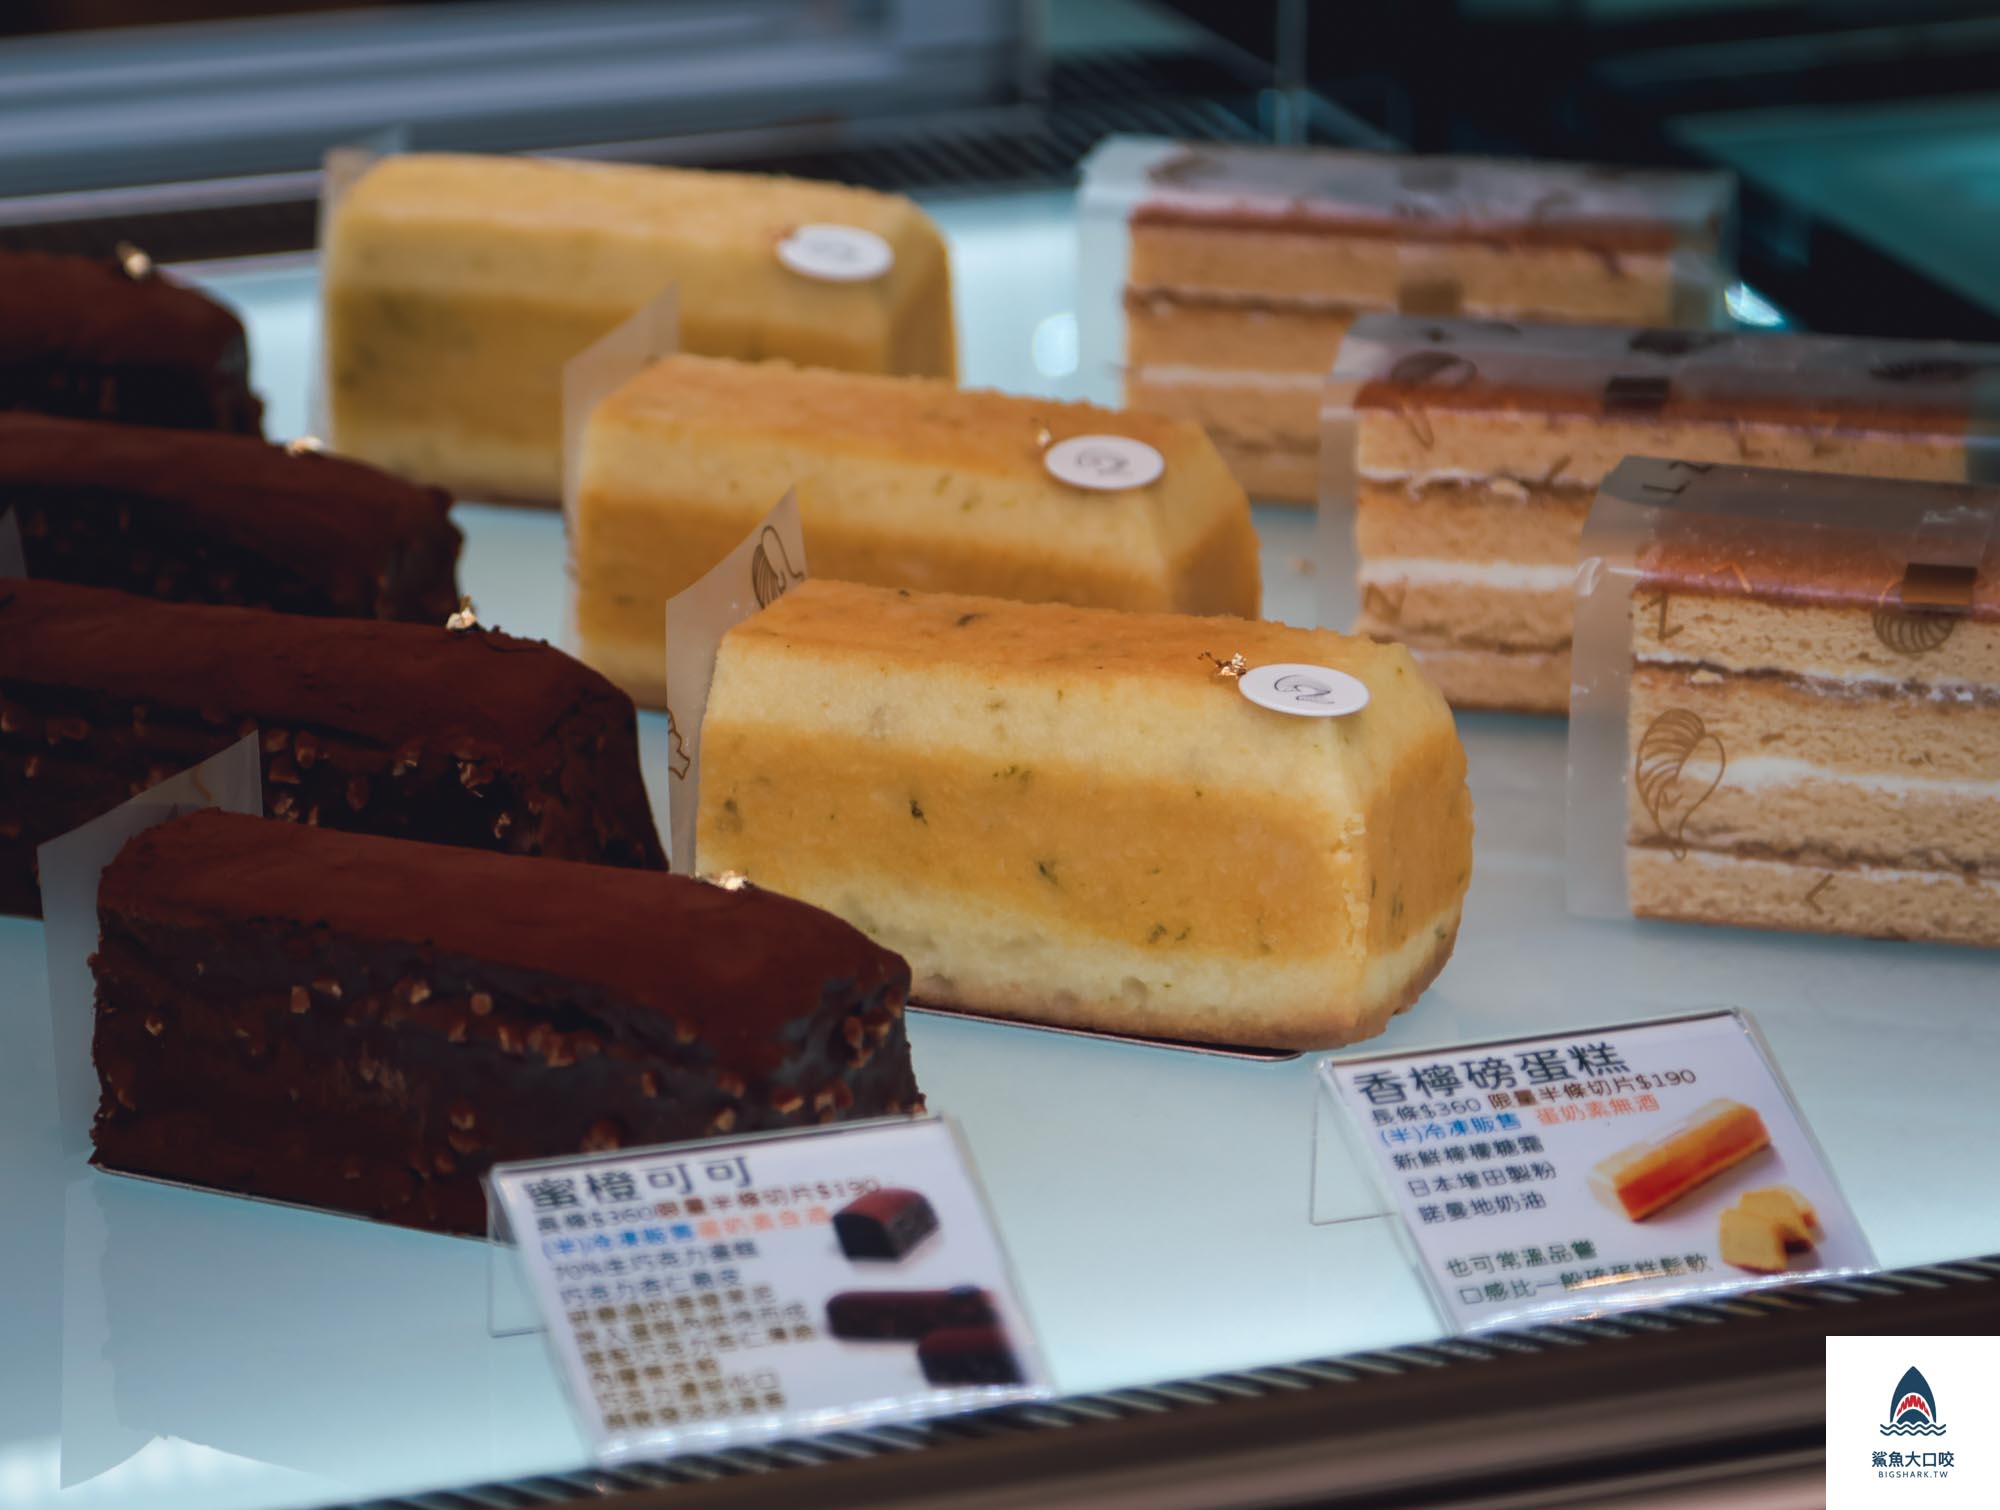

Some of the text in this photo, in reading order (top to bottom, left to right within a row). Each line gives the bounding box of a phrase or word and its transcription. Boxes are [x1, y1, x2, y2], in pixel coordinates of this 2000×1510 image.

[1354, 1042, 1632, 1105] 香檸磅蛋糕
